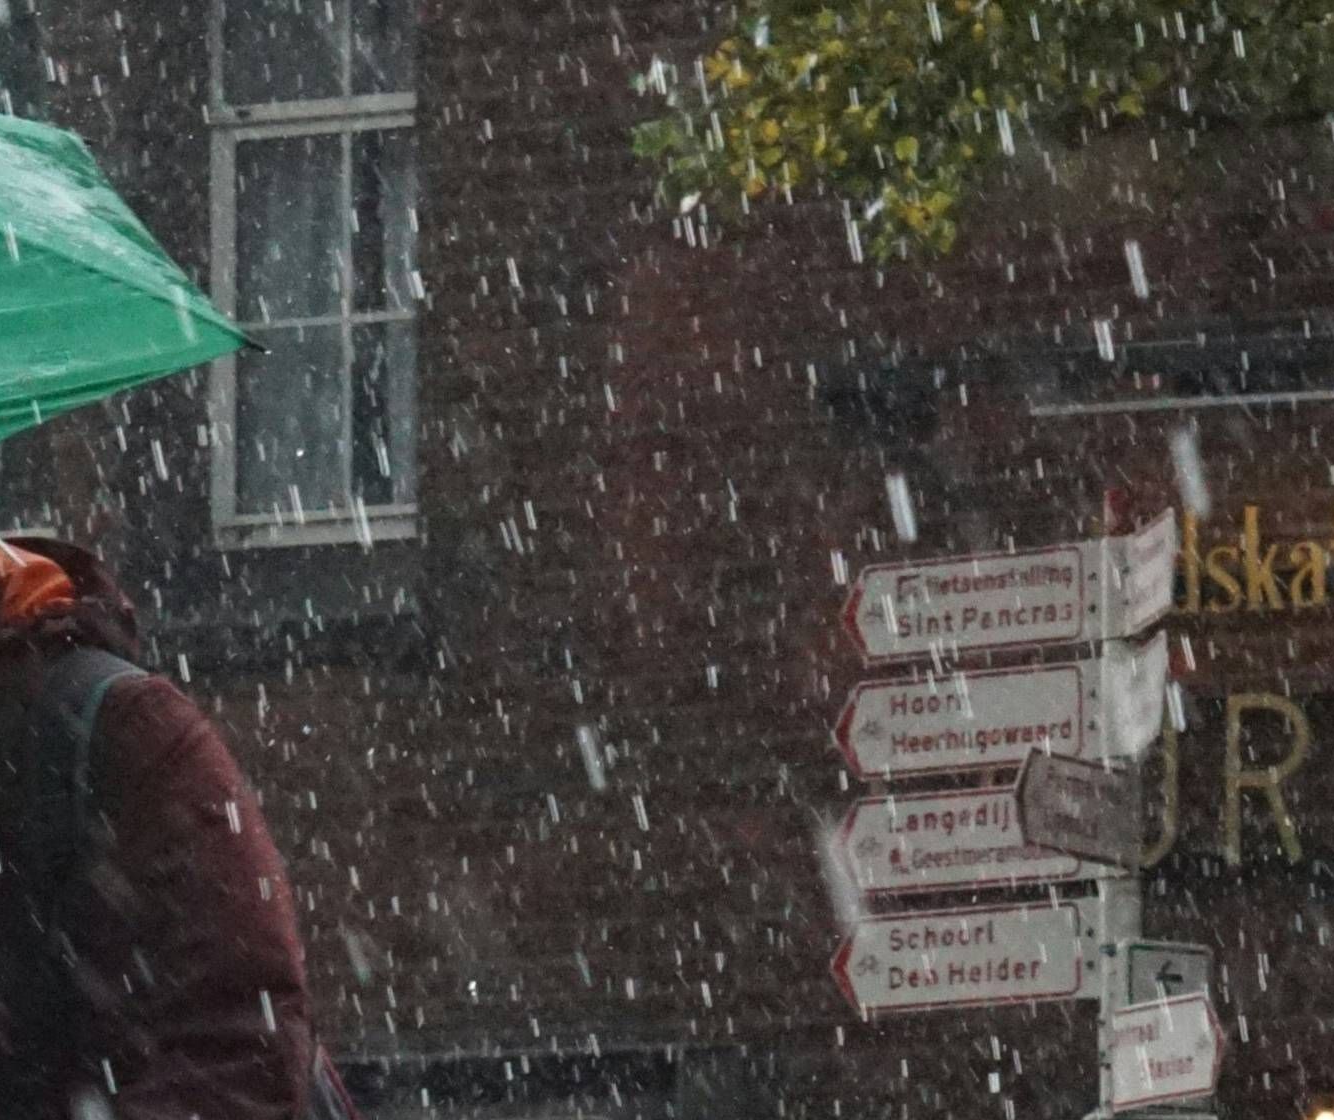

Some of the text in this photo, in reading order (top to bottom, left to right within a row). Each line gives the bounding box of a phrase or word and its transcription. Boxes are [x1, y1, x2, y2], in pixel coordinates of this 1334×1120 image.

[898, 602, 1073, 638] Sint Pancras
[891, 718, 1072, 755] Heerhugowaard
[888, 801, 1013, 836] Langedij
[888, 957, 1040, 990] Den Helder
